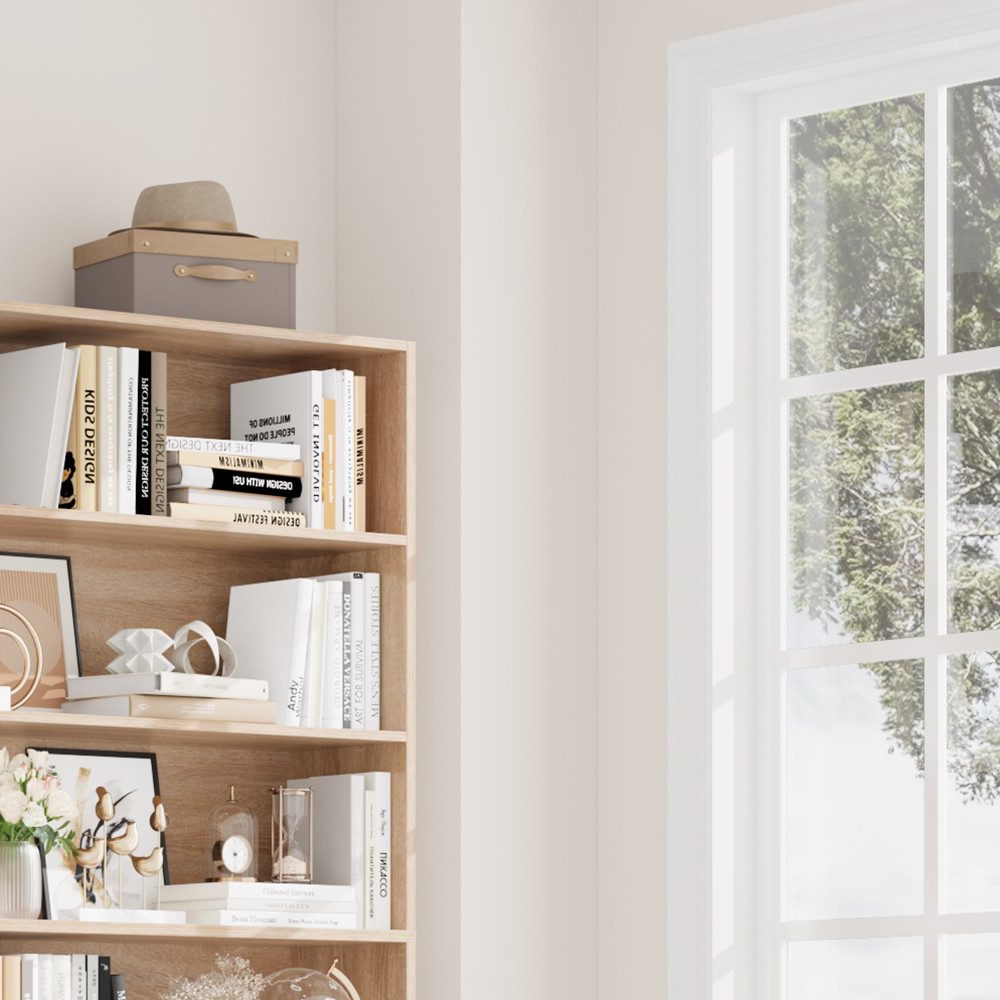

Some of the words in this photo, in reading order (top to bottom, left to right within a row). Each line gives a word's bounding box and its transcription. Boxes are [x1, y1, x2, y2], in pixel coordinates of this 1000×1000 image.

[343, 593, 351, 666] DONATELLA
[354, 639, 363, 682] SURVIVAL
[287, 679, 299, 711] Andy
[343, 667, 351, 722] VERSACE
[354, 685, 363, 704] FOR
[354, 707, 364, 725] ART
[379, 852, 388, 898] ПИКАССО
